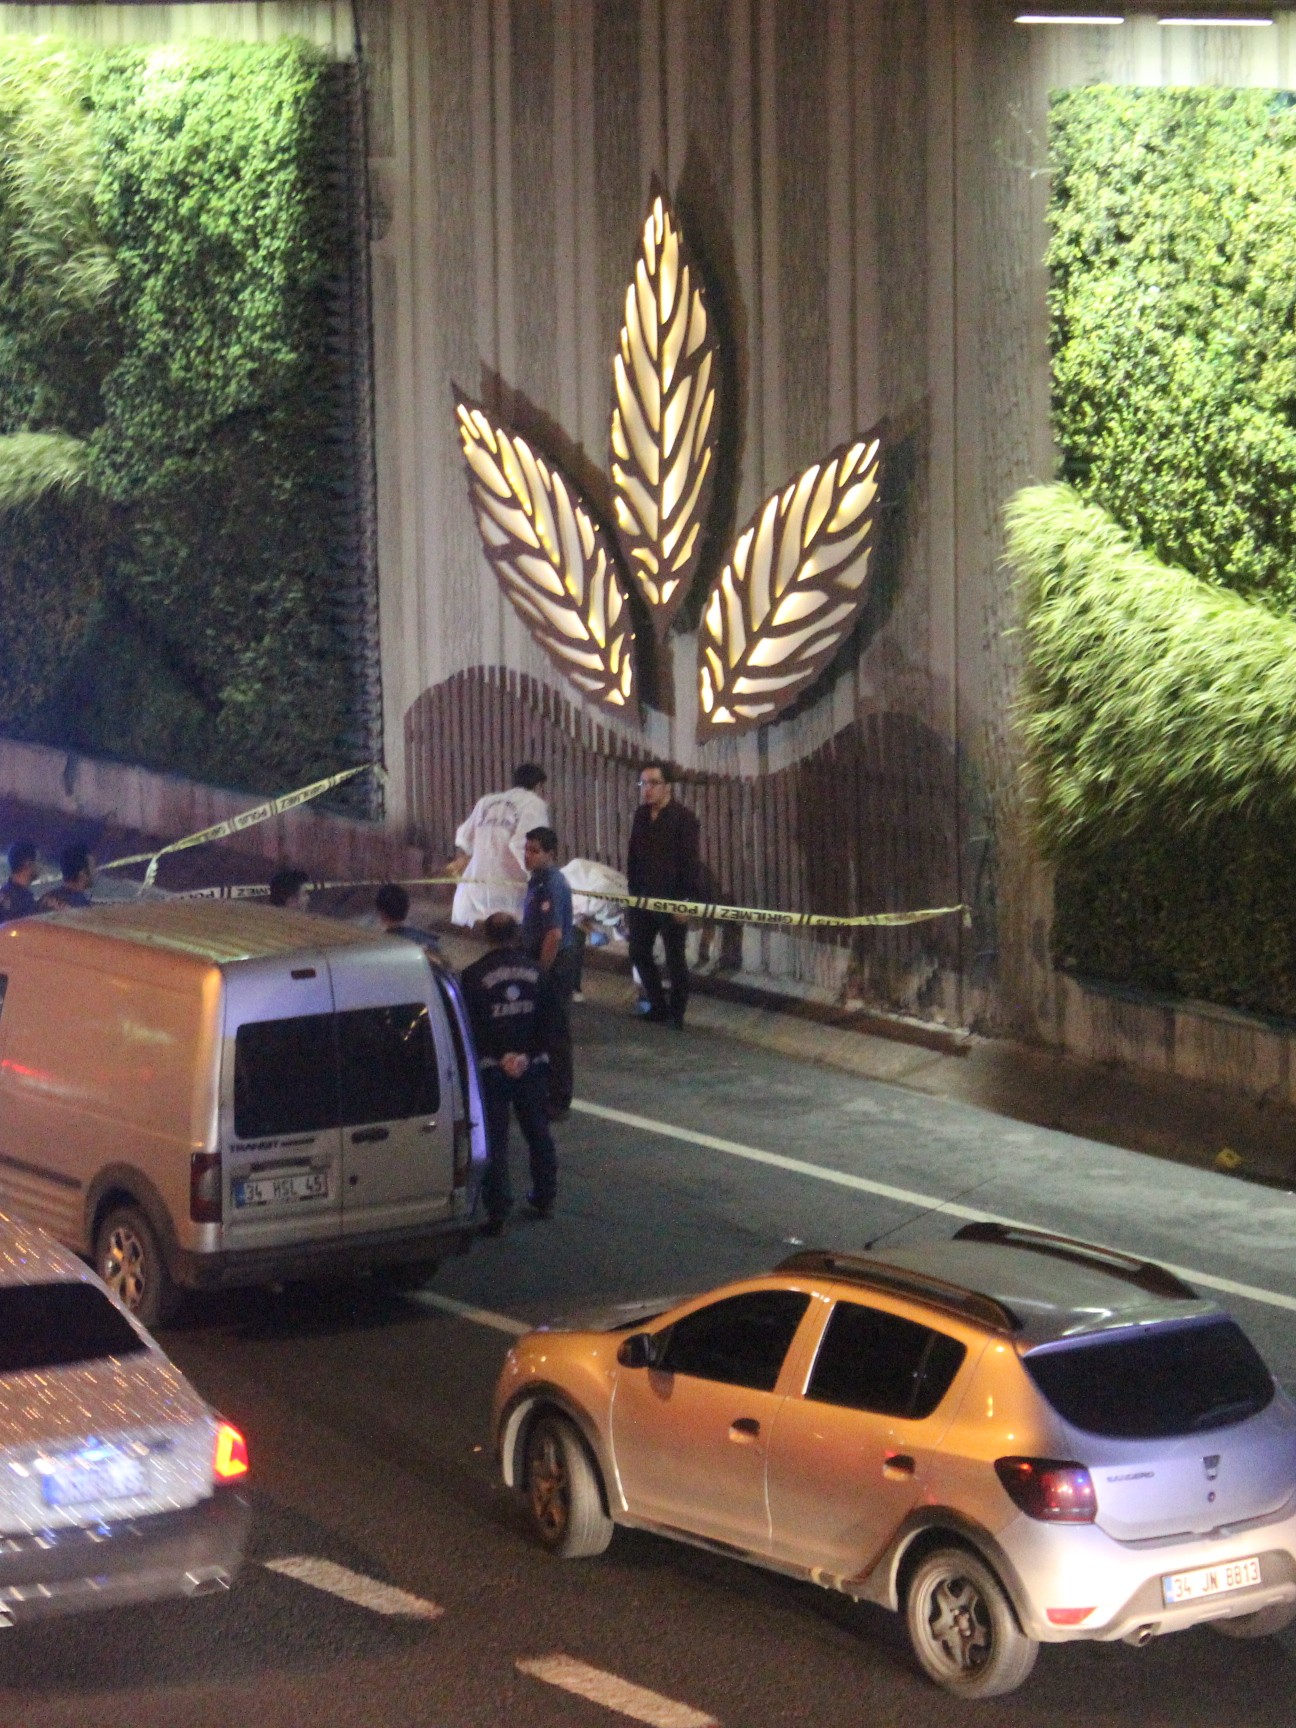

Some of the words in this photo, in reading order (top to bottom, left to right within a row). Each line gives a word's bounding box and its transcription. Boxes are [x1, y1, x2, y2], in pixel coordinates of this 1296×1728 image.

[653, 901, 699, 916] POLIS
[246, 1182, 263, 1201] 34
[306, 1175, 323, 1192] 45
[1174, 1578, 1192, 1598] 34
[1202, 1571, 1218, 1592] JN
[1226, 1561, 1259, 1587] 8813
